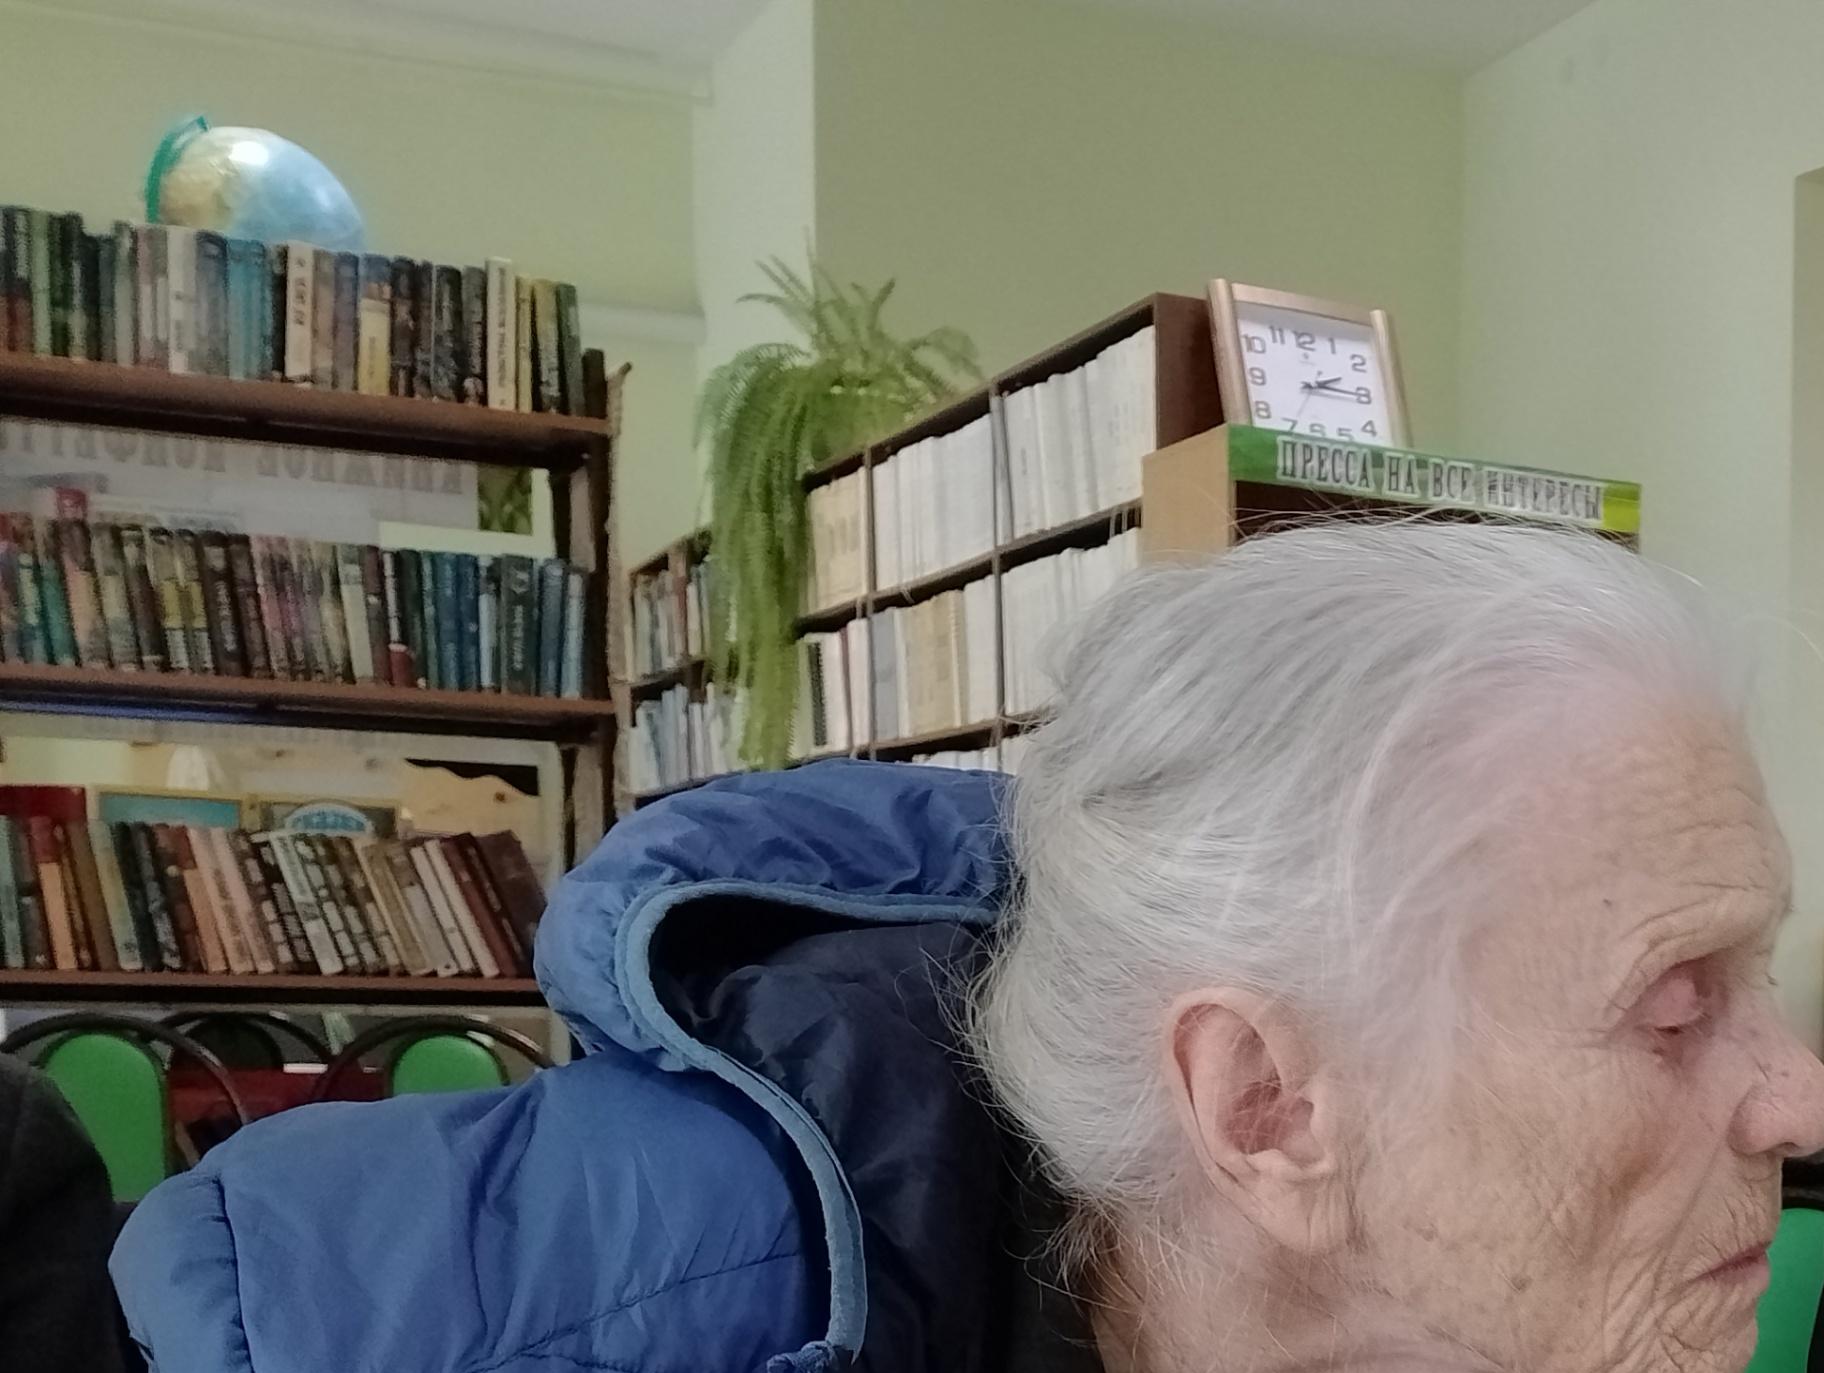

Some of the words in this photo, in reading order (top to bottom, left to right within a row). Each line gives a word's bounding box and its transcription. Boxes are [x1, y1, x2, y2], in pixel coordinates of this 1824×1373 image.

[1241, 333, 1267, 354] 10
[1268, 325, 1286, 345] 11
[1293, 330, 1317, 352] 12
[1327, 337, 1338, 354] 1
[1350, 353, 1368, 373] 2
[1248, 366, 1267, 386] 9
[1355, 386, 1372, 405] 3
[1253, 400, 1272, 420] 8
[1361, 420, 1378, 437] 4
[1281, 440, 1370, 489] ПРЕССА
[1388, 455, 1416, 495] НА
[1433, 462, 1472, 499] ВСЕ
[1487, 469, 1601, 520] ИНТЕРЕСЫ
